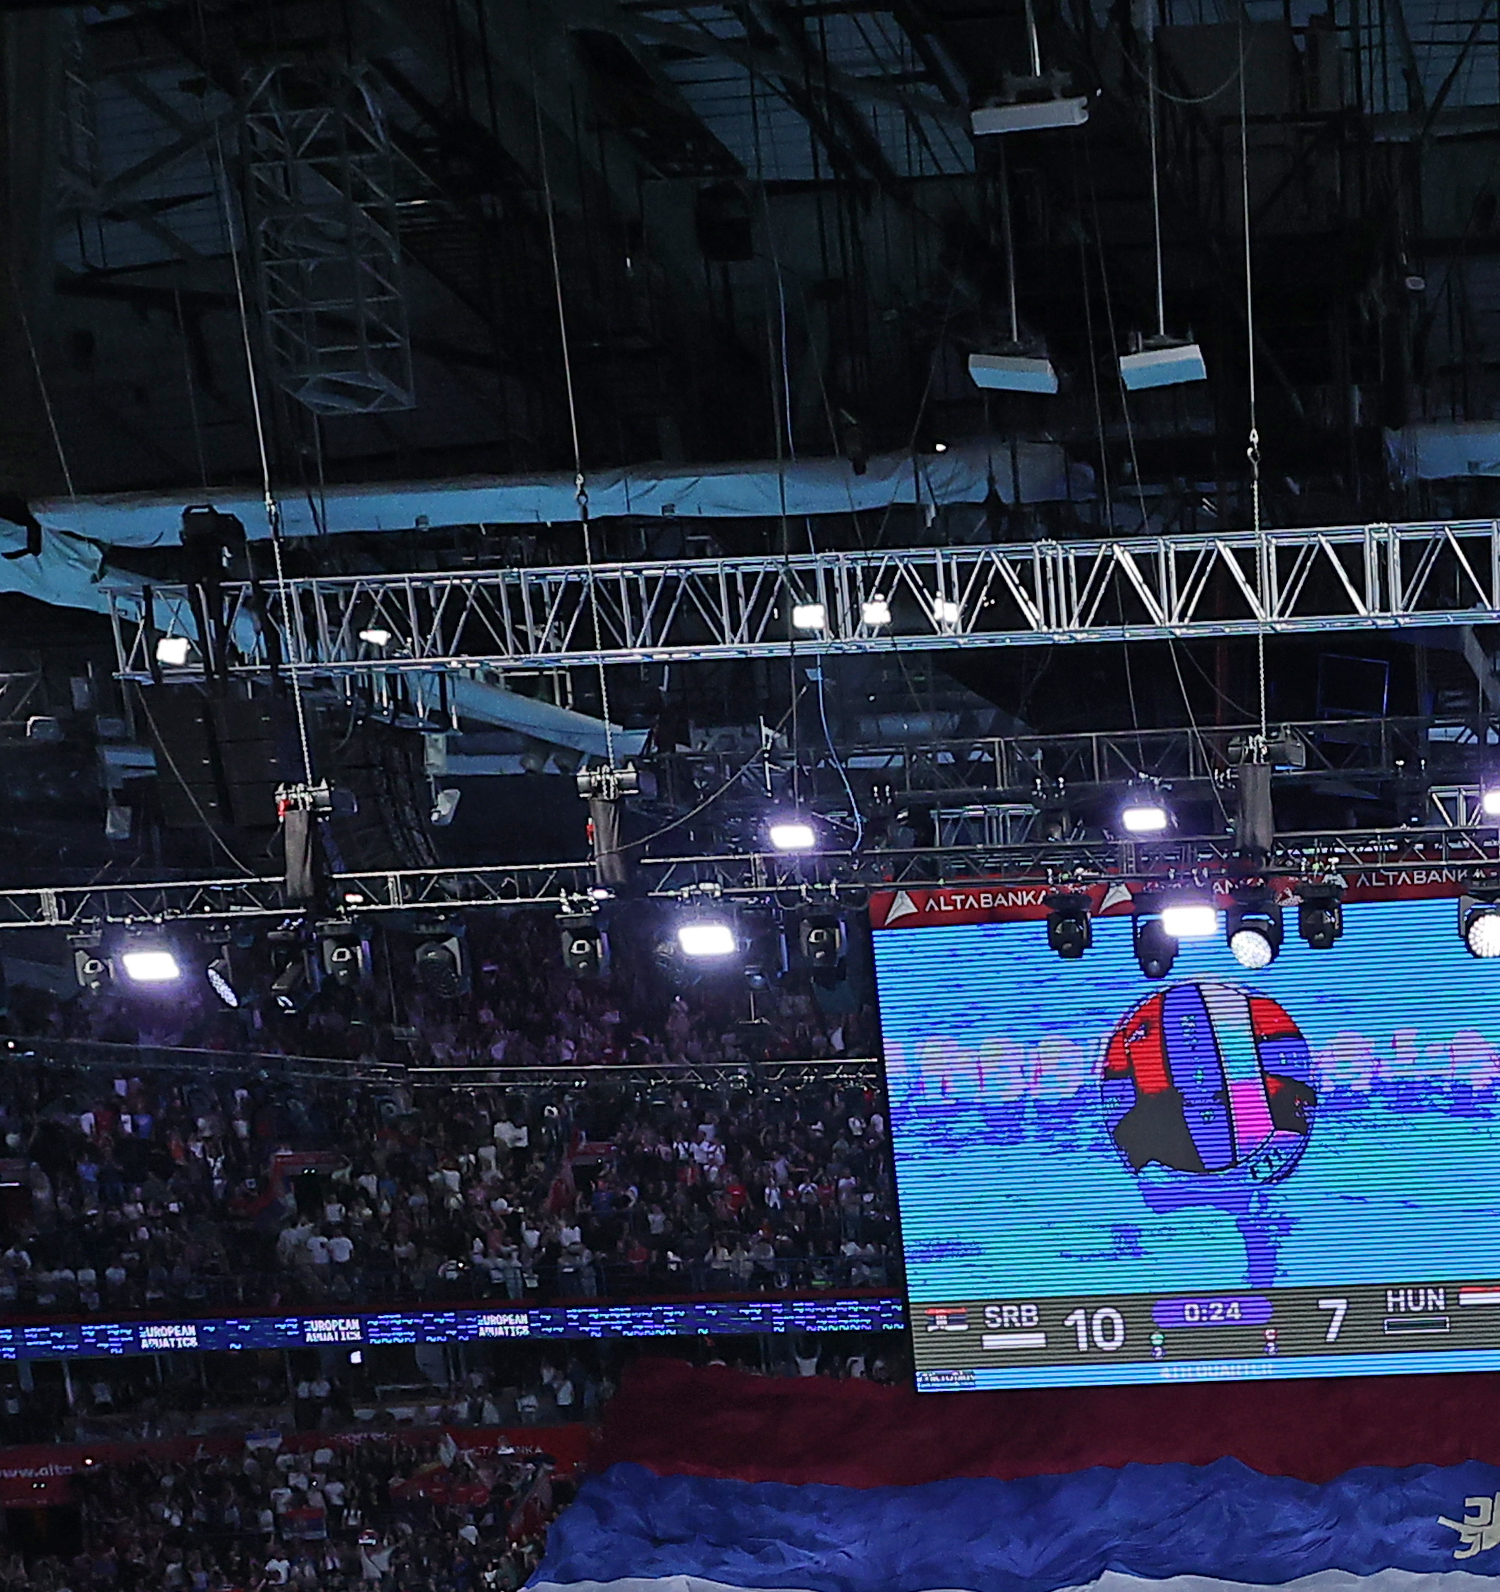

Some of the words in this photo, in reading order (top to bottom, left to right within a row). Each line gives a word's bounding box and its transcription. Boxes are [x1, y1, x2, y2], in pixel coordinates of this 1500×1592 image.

[1183, 1302, 1242, 1323] 0:24
[1386, 1287, 1446, 1313] HUN
[984, 1304, 1039, 1329] SRB
[1064, 1307, 1126, 1352] 10
[1318, 1299, 1348, 1343] 7
